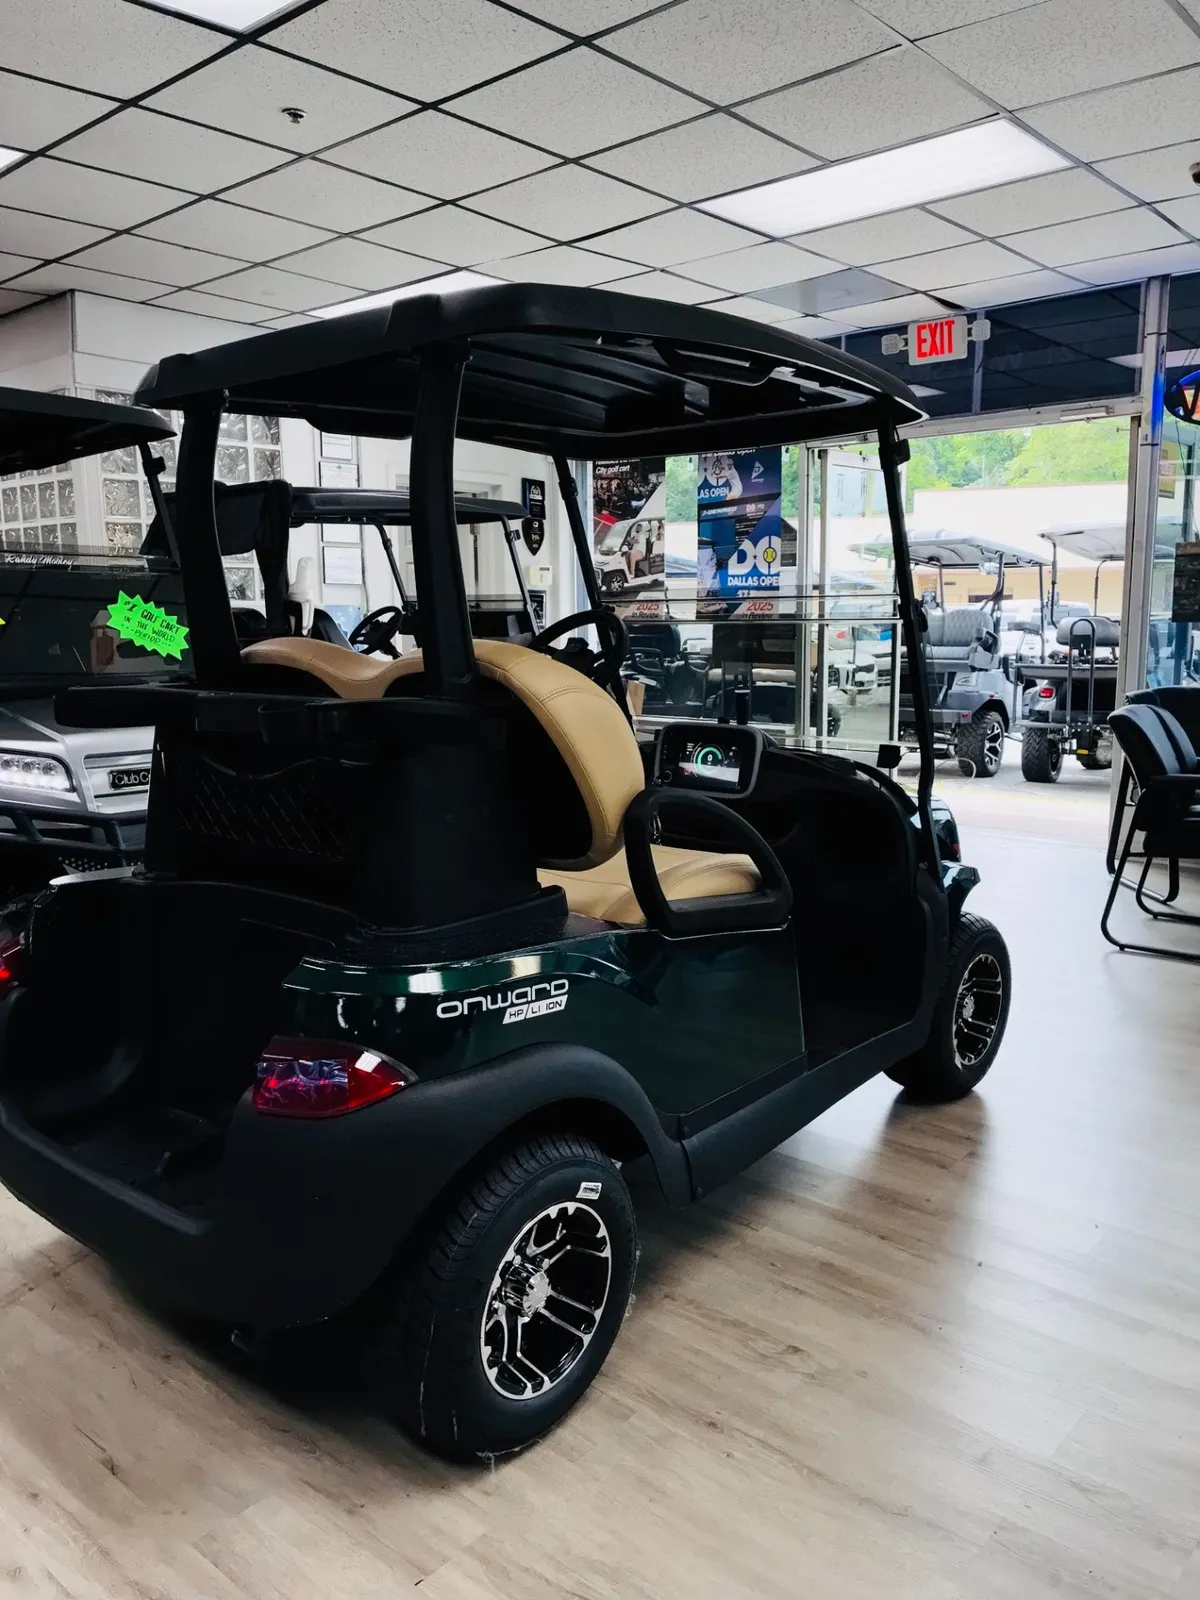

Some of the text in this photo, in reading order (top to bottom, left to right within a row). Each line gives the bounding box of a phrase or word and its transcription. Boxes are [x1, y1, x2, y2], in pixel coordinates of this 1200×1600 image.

[916, 319, 955, 359] EXIT
[607, 465, 620, 475] golf
[619, 464, 631, 473] cart
[710, 486, 730, 498] OPEN
[5, 553, 38, 571] Randy
[727, 574, 780, 587] DALLAS OPE
[636, 603, 660, 611] 2025
[746, 601, 774, 611] 2025
[123, 615, 176, 643] IN THE WORLD
[160, 619, 180, 635] CART
[115, 771, 150, 785] Club C
